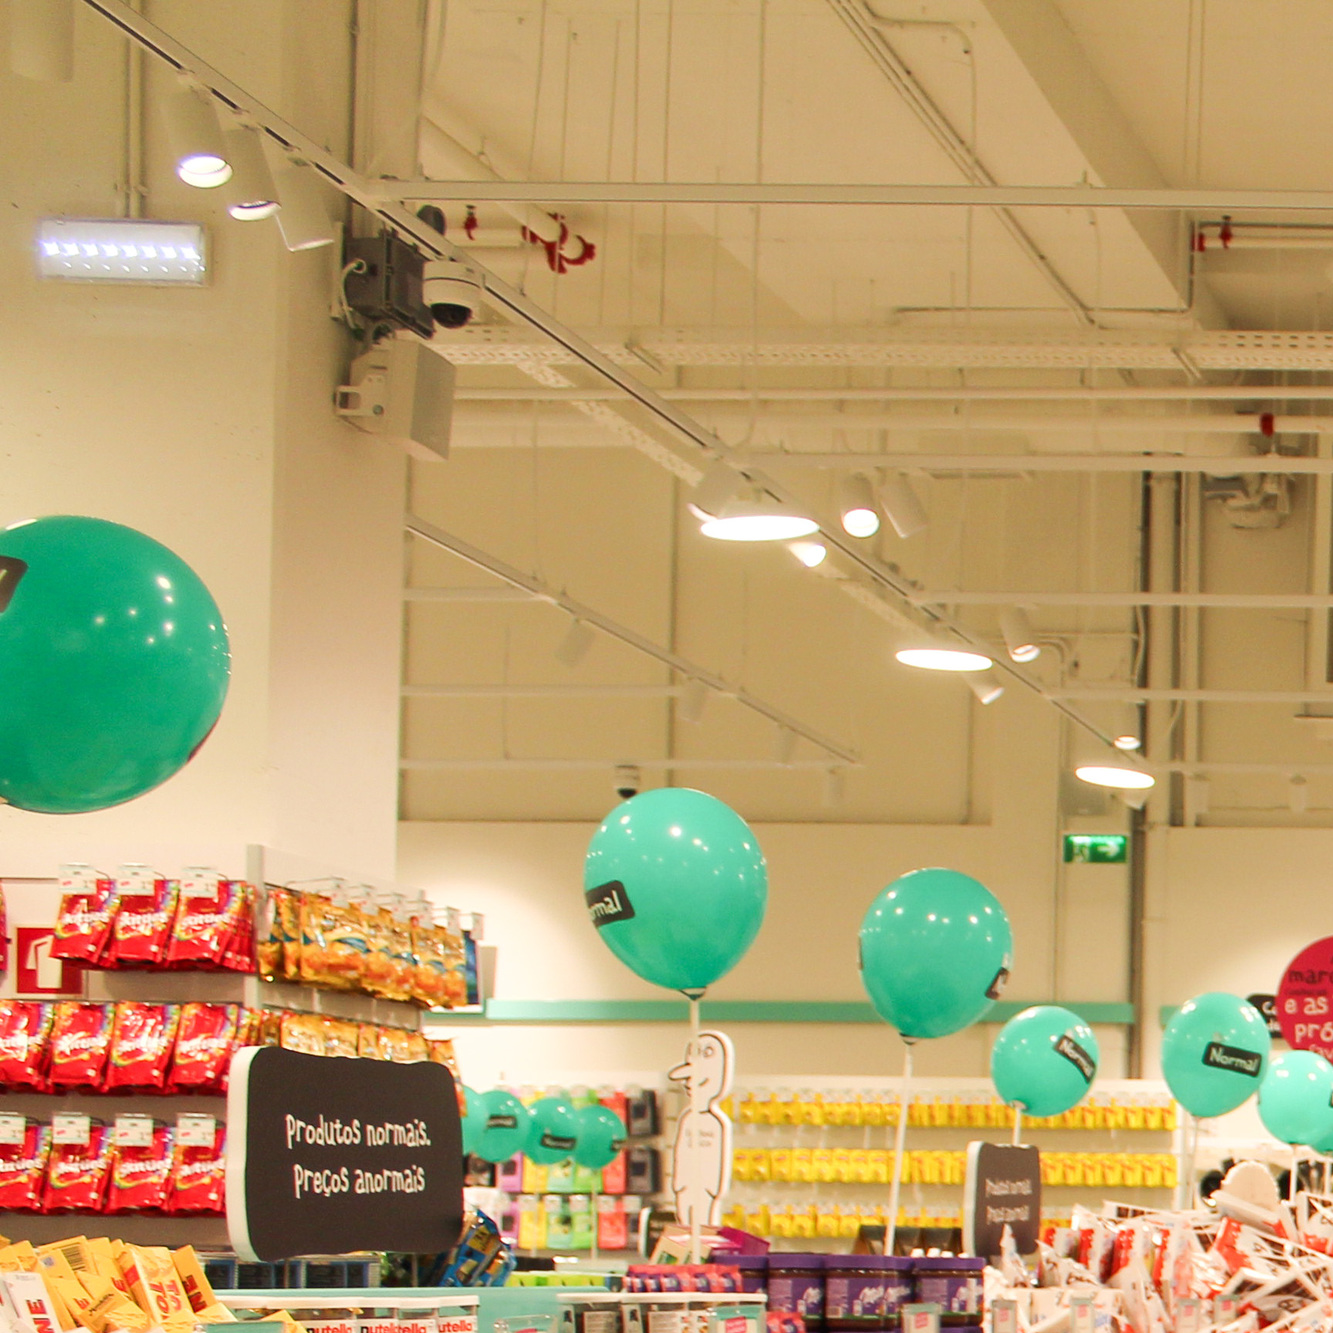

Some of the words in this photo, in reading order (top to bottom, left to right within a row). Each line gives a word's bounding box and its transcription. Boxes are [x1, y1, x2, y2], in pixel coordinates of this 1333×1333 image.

[1303, 996, 1328, 1016] as
[1209, 1045, 1260, 1073] Normal
[286, 1115, 361, 1148] Produtos
[367, 1119, 431, 1147] normais.
[294, 1165, 349, 1198] Preços
[355, 1163, 425, 1194] anormais
